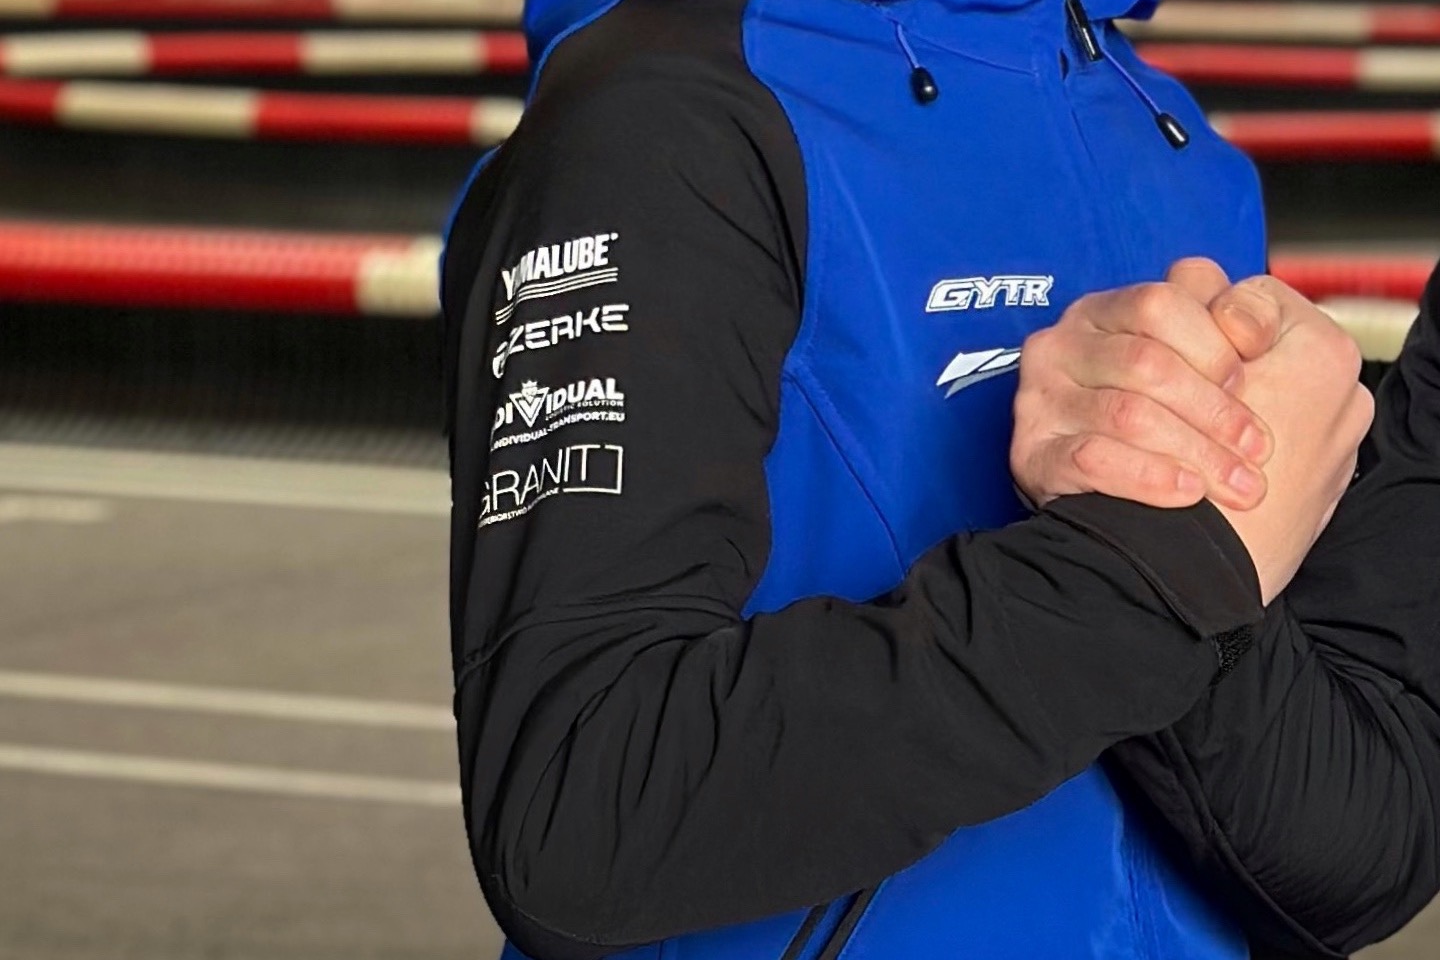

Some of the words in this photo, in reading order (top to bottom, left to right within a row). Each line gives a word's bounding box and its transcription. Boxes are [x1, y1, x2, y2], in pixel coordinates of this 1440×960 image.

[501, 232, 619, 301] YMALUBE
[925, 275, 1054, 312] GYTR
[491, 377, 625, 430] DIVIDUAL
